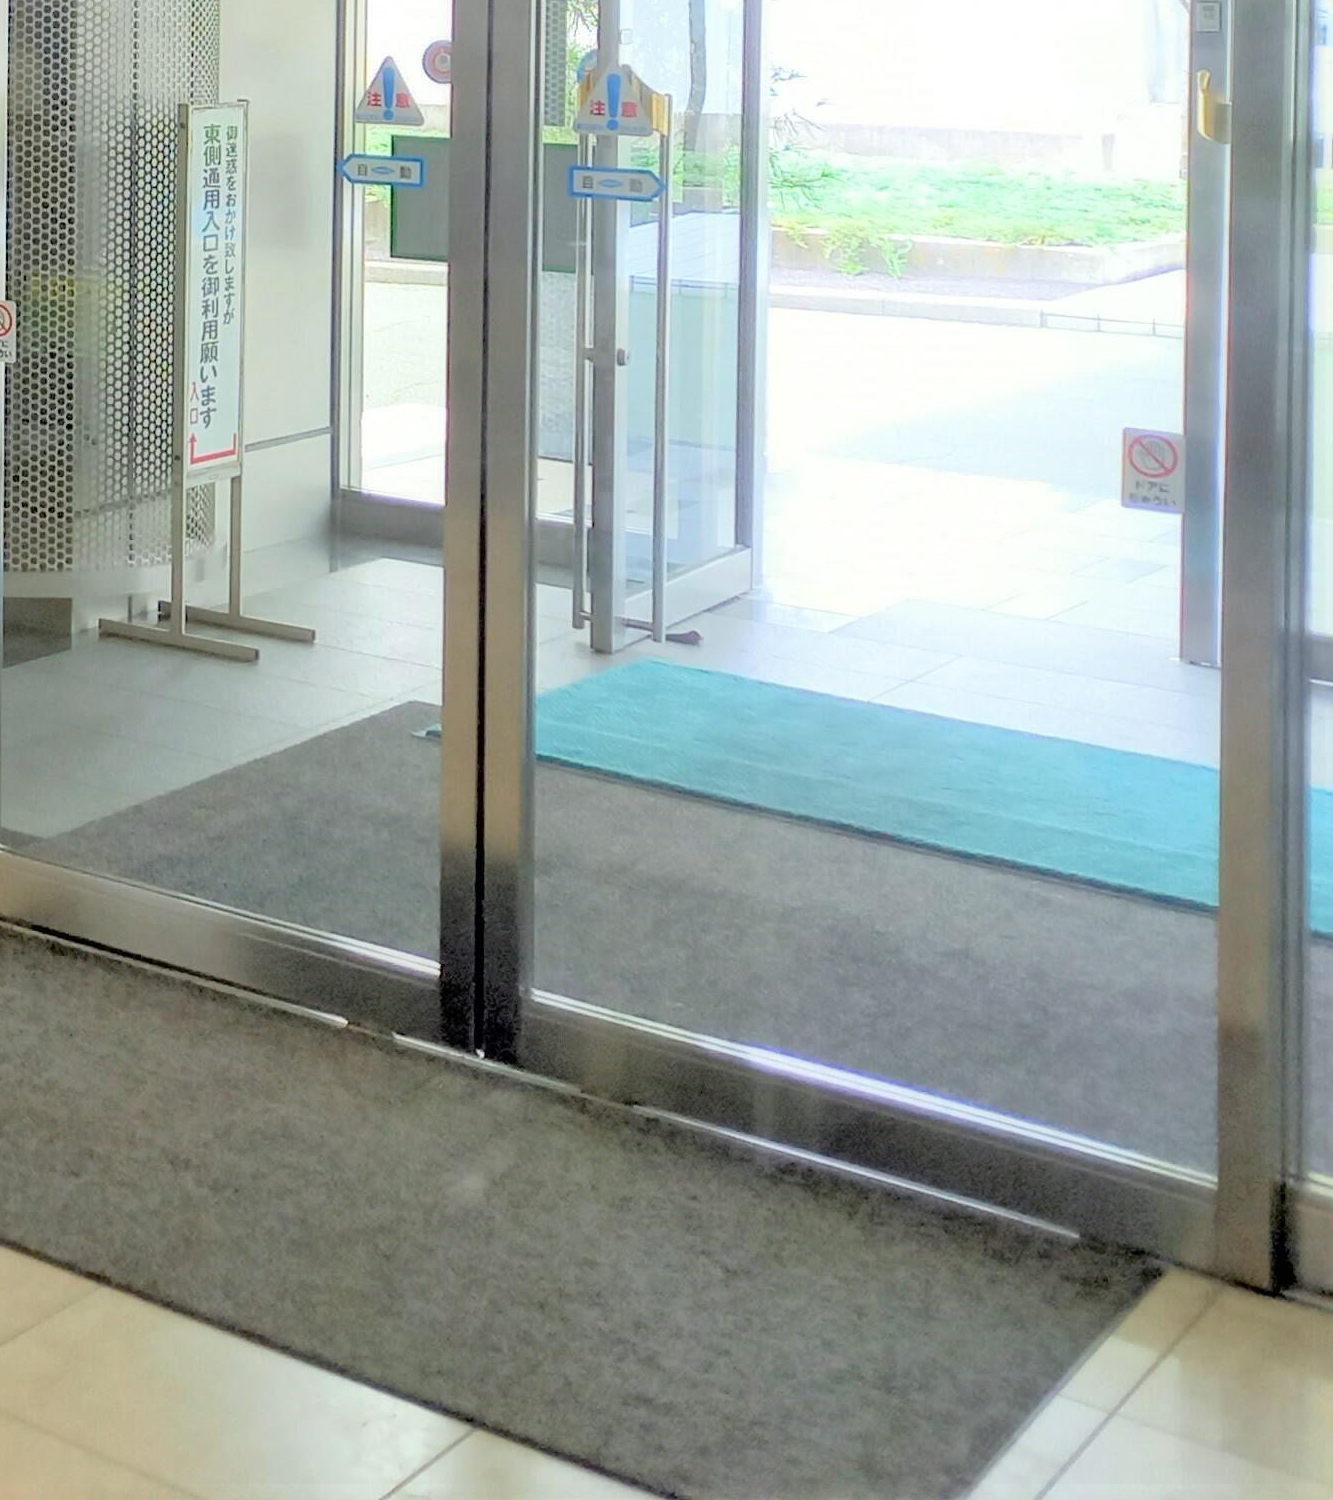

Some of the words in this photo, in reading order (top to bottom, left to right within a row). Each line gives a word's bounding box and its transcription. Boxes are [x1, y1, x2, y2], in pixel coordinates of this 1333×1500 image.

[199, 123, 222, 429] 東側通用入口を御利用願います
[190, 381, 200, 425] 入口
